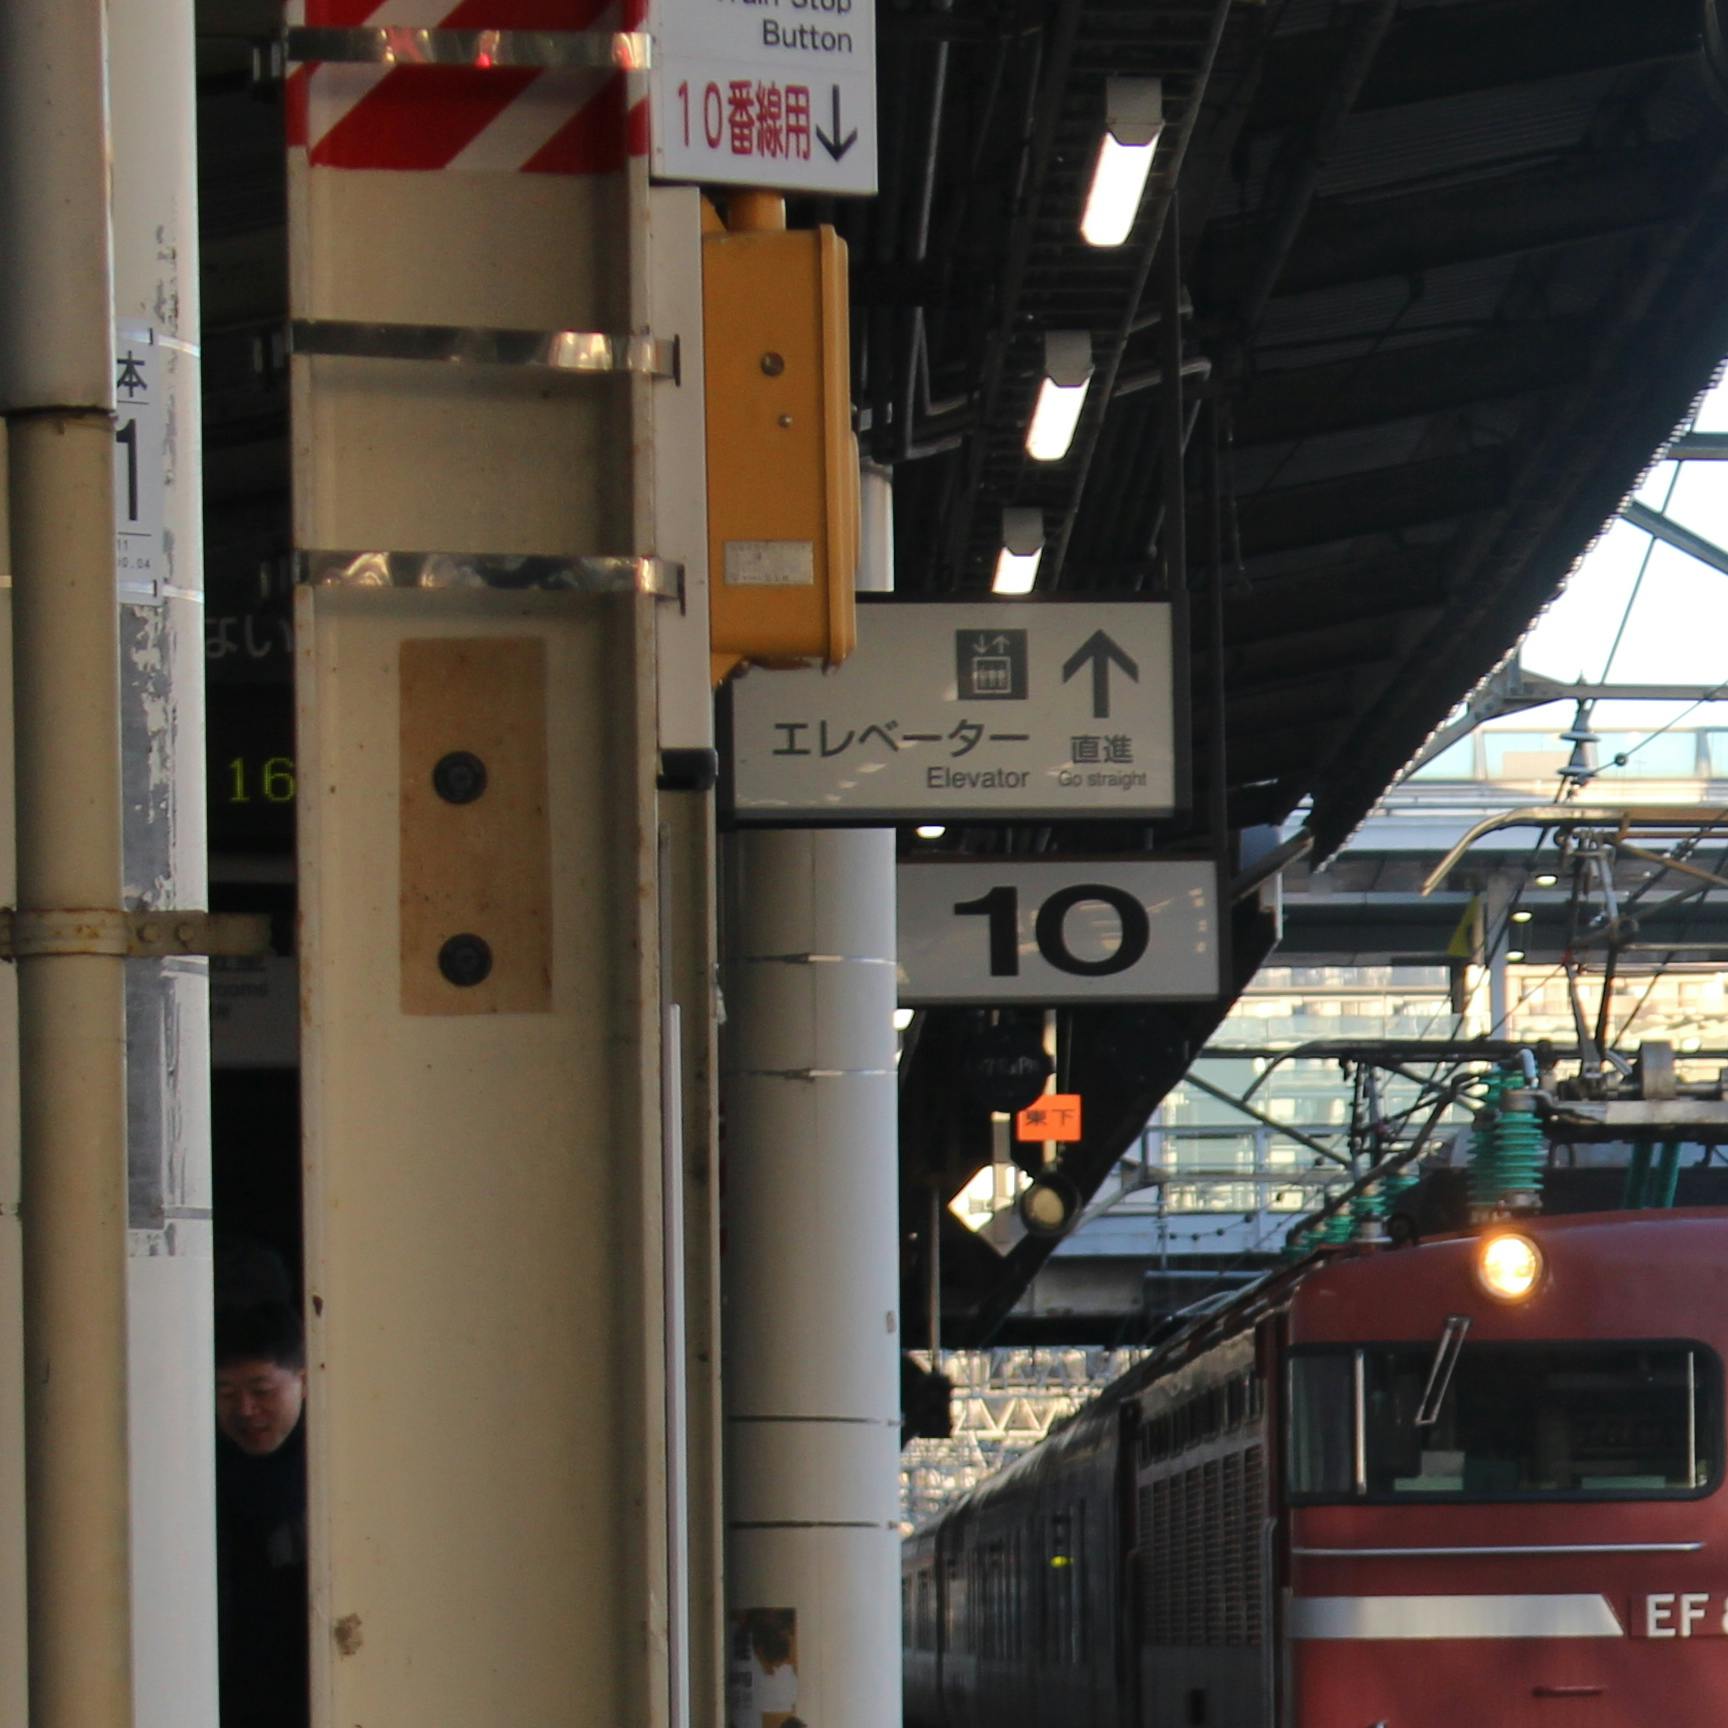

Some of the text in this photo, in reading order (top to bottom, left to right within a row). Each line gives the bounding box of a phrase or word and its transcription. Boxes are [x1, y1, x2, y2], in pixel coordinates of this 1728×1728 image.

[763, 18, 852, 53] Button
[678, 80, 810, 160] 10番線用
[772, 719, 1133, 764] エレベーター 直進
[229, 757, 295, 801] 16
[927, 767, 1147, 790] Elevator Go straight
[954, 883, 1149, 977] 10
[1646, 1592, 1709, 1638] EF
